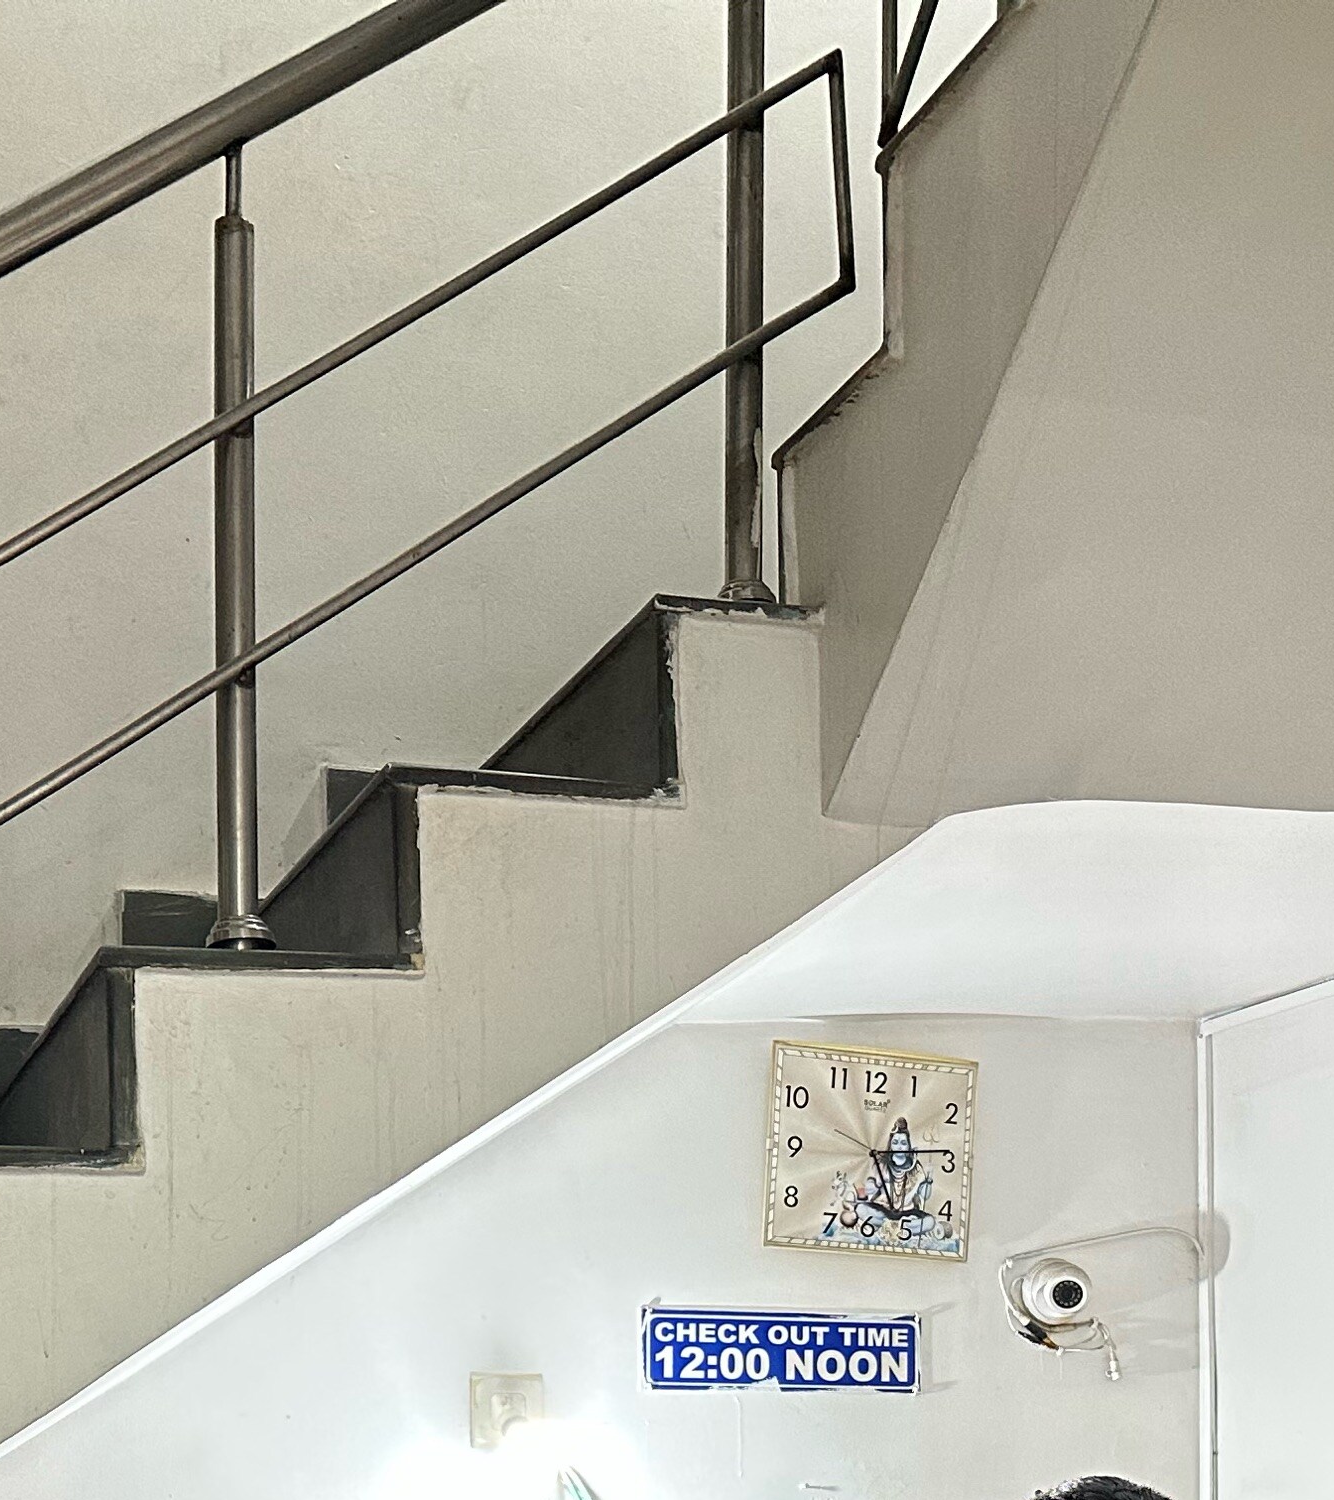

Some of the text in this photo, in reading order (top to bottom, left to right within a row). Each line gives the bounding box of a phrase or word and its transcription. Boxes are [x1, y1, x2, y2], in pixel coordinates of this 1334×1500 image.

[831, 1066, 848, 1090] 11
[865, 1070, 888, 1095] 12
[911, 1075, 917, 1098] 1
[785, 1085, 809, 1109] 10
[944, 1102, 959, 1125] 2
[787, 1135, 803, 1158] 9
[941, 1150, 956, 1174] 3
[783, 1185, 799, 1208] 8
[938, 1200, 953, 1221] 4
[823, 1212, 838, 1234] 7
[860, 1215, 875, 1238] 6
[898, 1219, 912, 1241] 5
[654, 1322, 909, 1347] CHECK OUT TIME
[654, 1345, 909, 1383] 12:00 NOON
